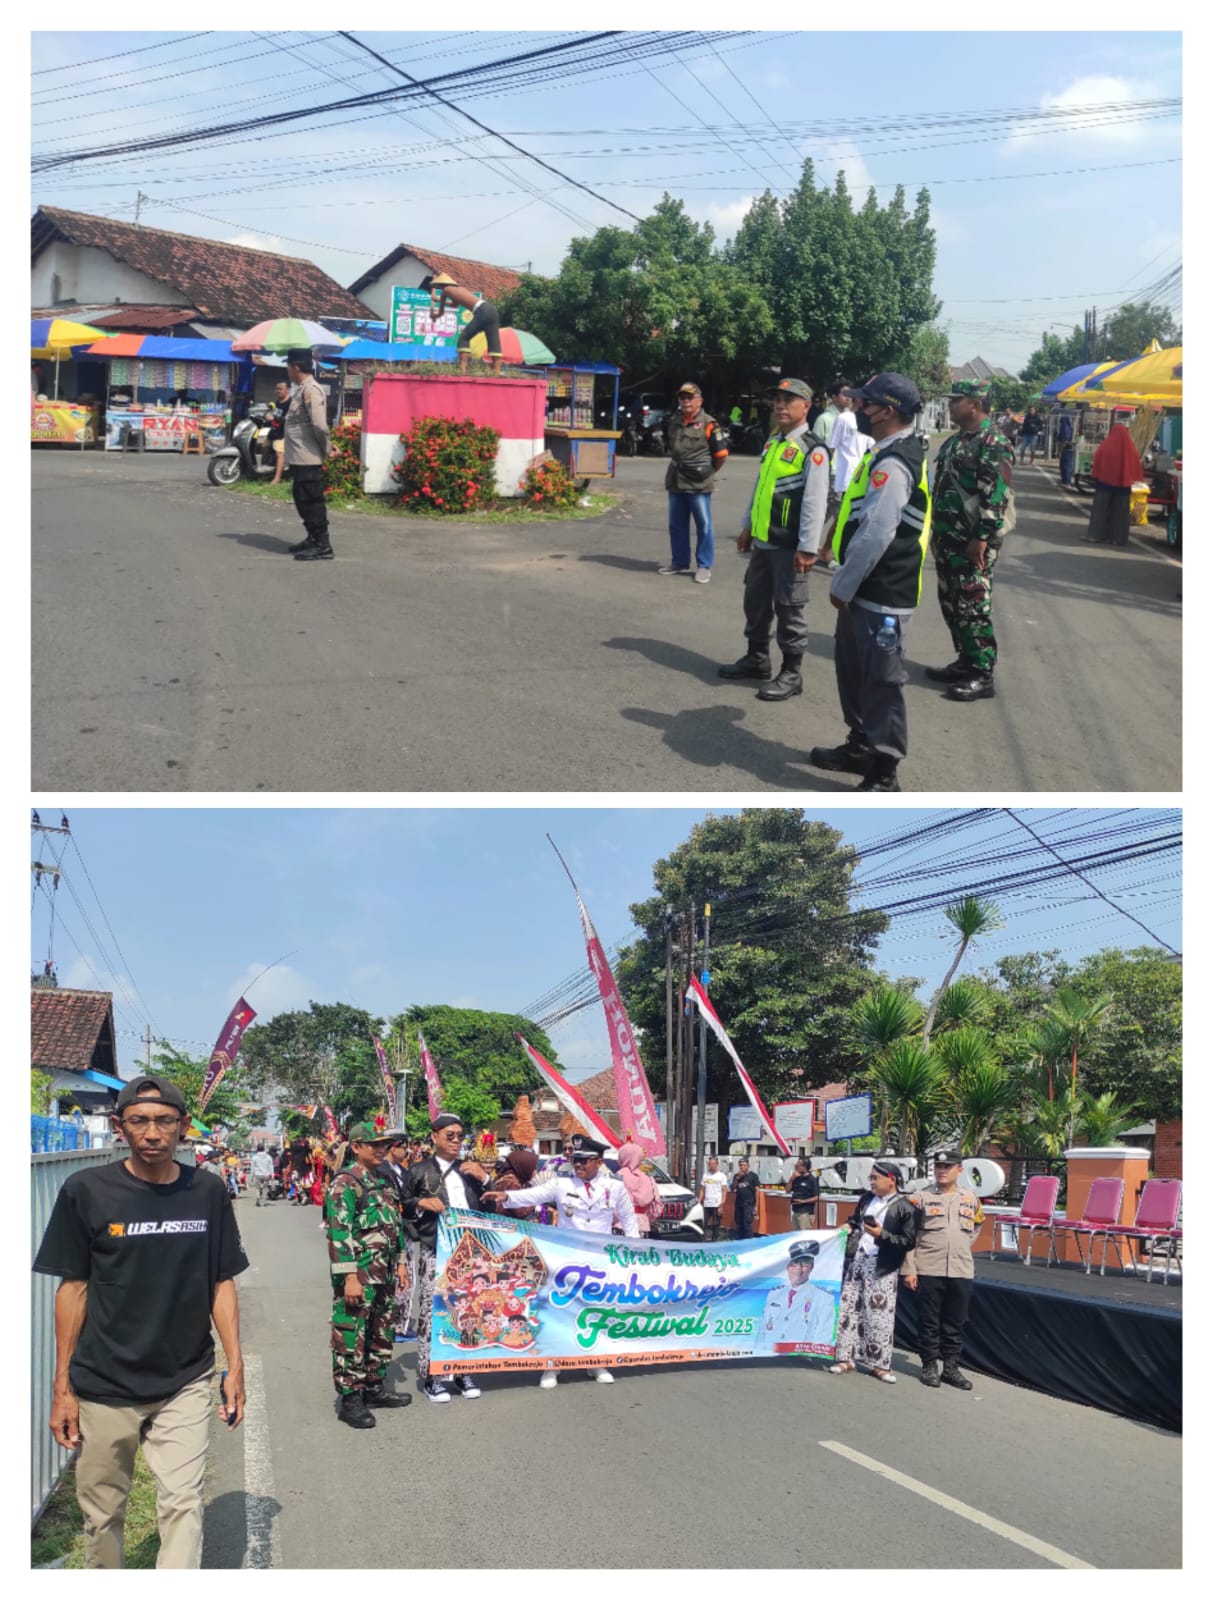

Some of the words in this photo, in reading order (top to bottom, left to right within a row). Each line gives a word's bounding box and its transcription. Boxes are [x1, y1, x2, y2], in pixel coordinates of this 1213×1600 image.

[143, 416, 198, 431] RYAN
[603, 1243, 660, 1267] Kirab
[665, 1248, 740, 1272] Budaya
[550, 1264, 742, 1308] Tembokrejo
[576, 1305, 711, 1349] Festival
[714, 1318, 754, 1335] 2025
